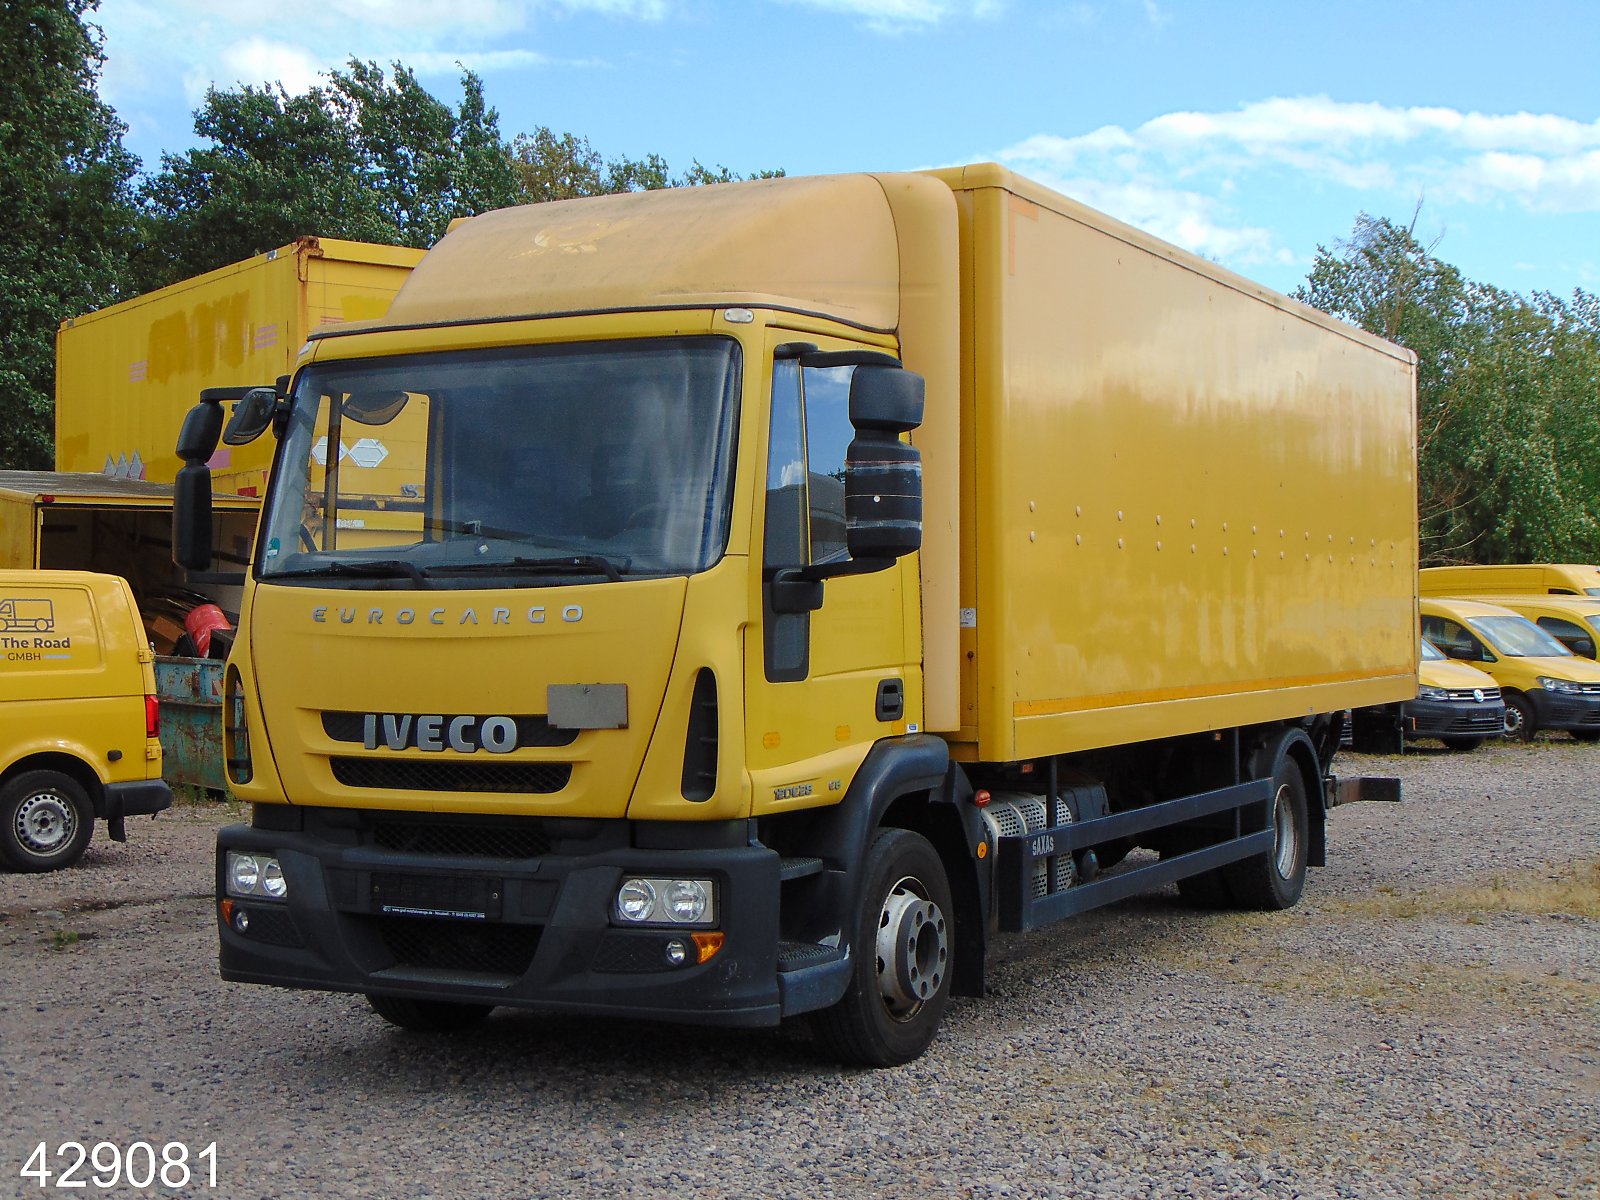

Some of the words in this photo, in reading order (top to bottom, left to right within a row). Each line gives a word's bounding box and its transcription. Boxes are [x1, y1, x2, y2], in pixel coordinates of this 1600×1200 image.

[312, 604, 584, 625] EUROCARGO
[1, 637, 29, 649] The
[33, 637, 71, 649] Road
[7, 652, 42, 661] GMBH
[363, 713, 518, 753] IVECO
[1032, 834, 1054, 856] SAXAS
